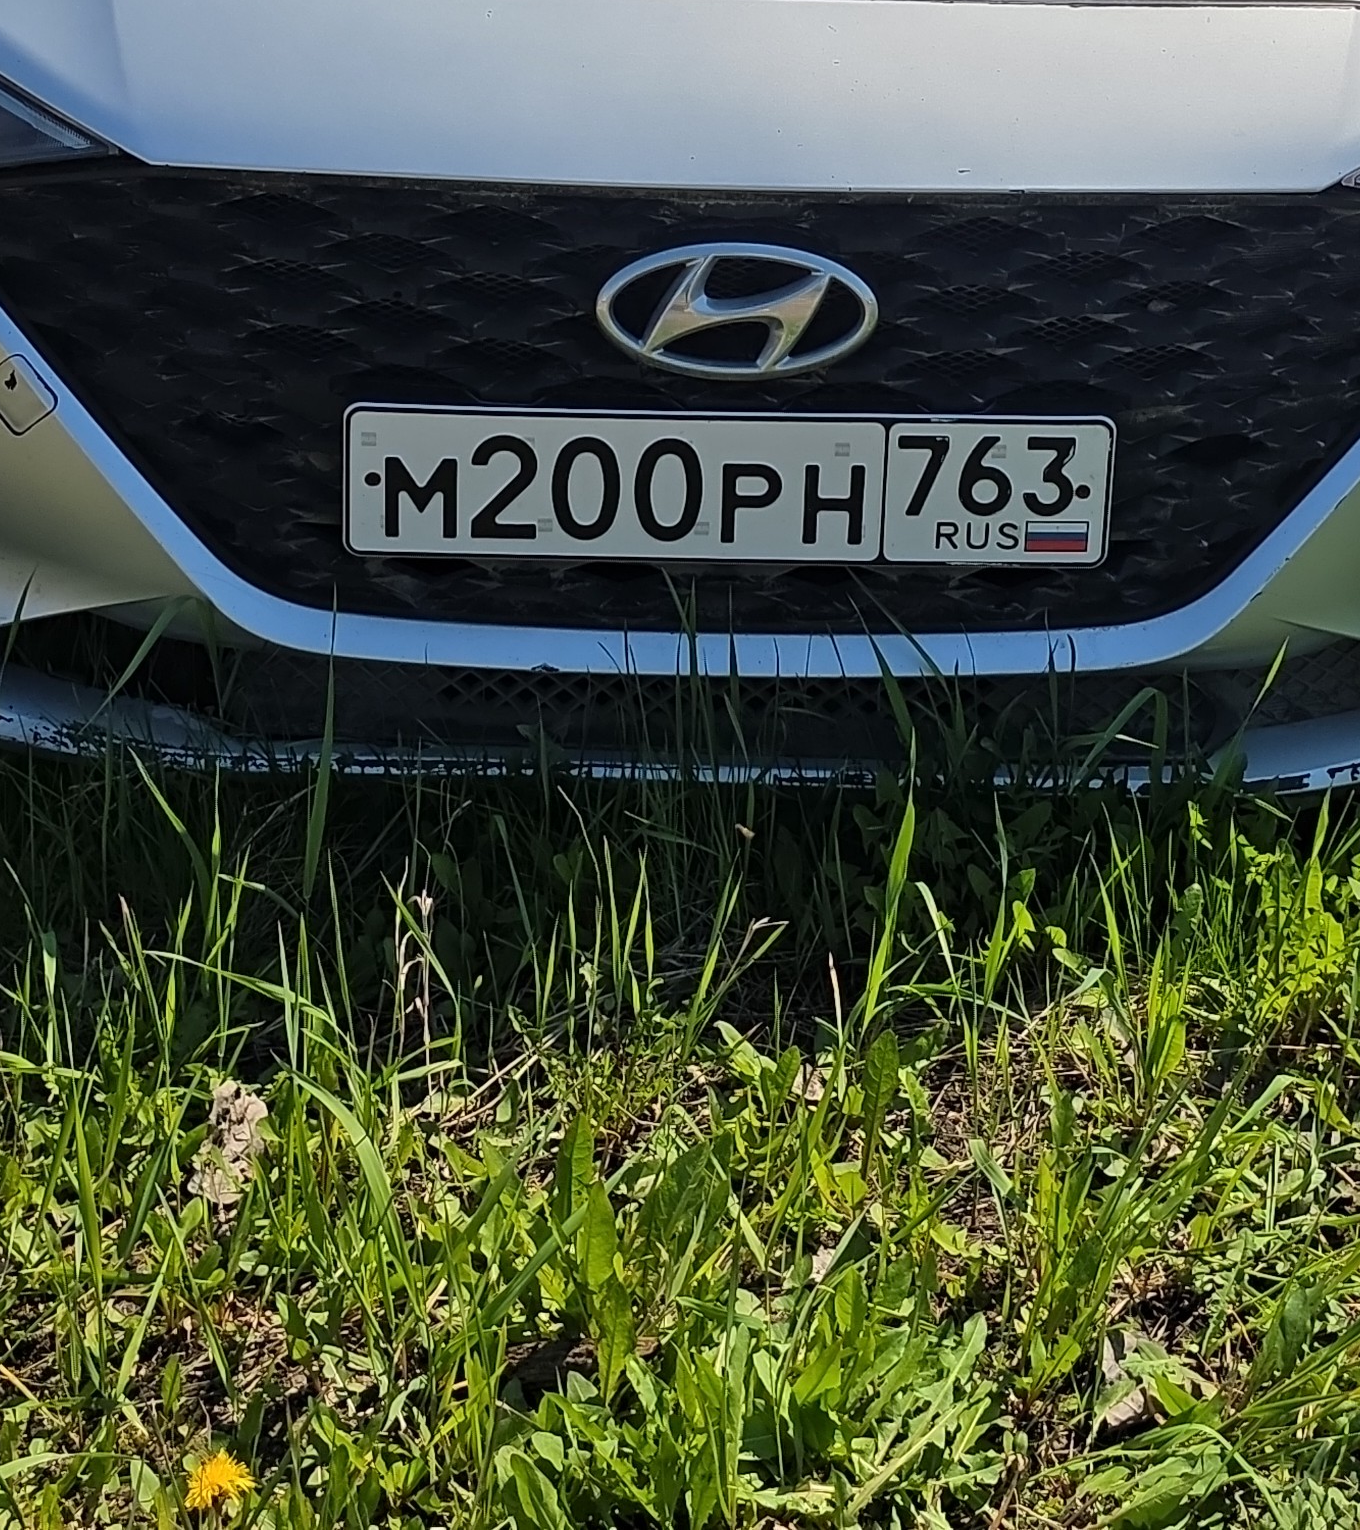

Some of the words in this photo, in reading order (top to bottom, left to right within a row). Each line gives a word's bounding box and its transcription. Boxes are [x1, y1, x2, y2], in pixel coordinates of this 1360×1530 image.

[384, 435, 867, 545] М200РН
[898, 435, 1076, 517] 763
[935, 521, 1019, 550] RUS
